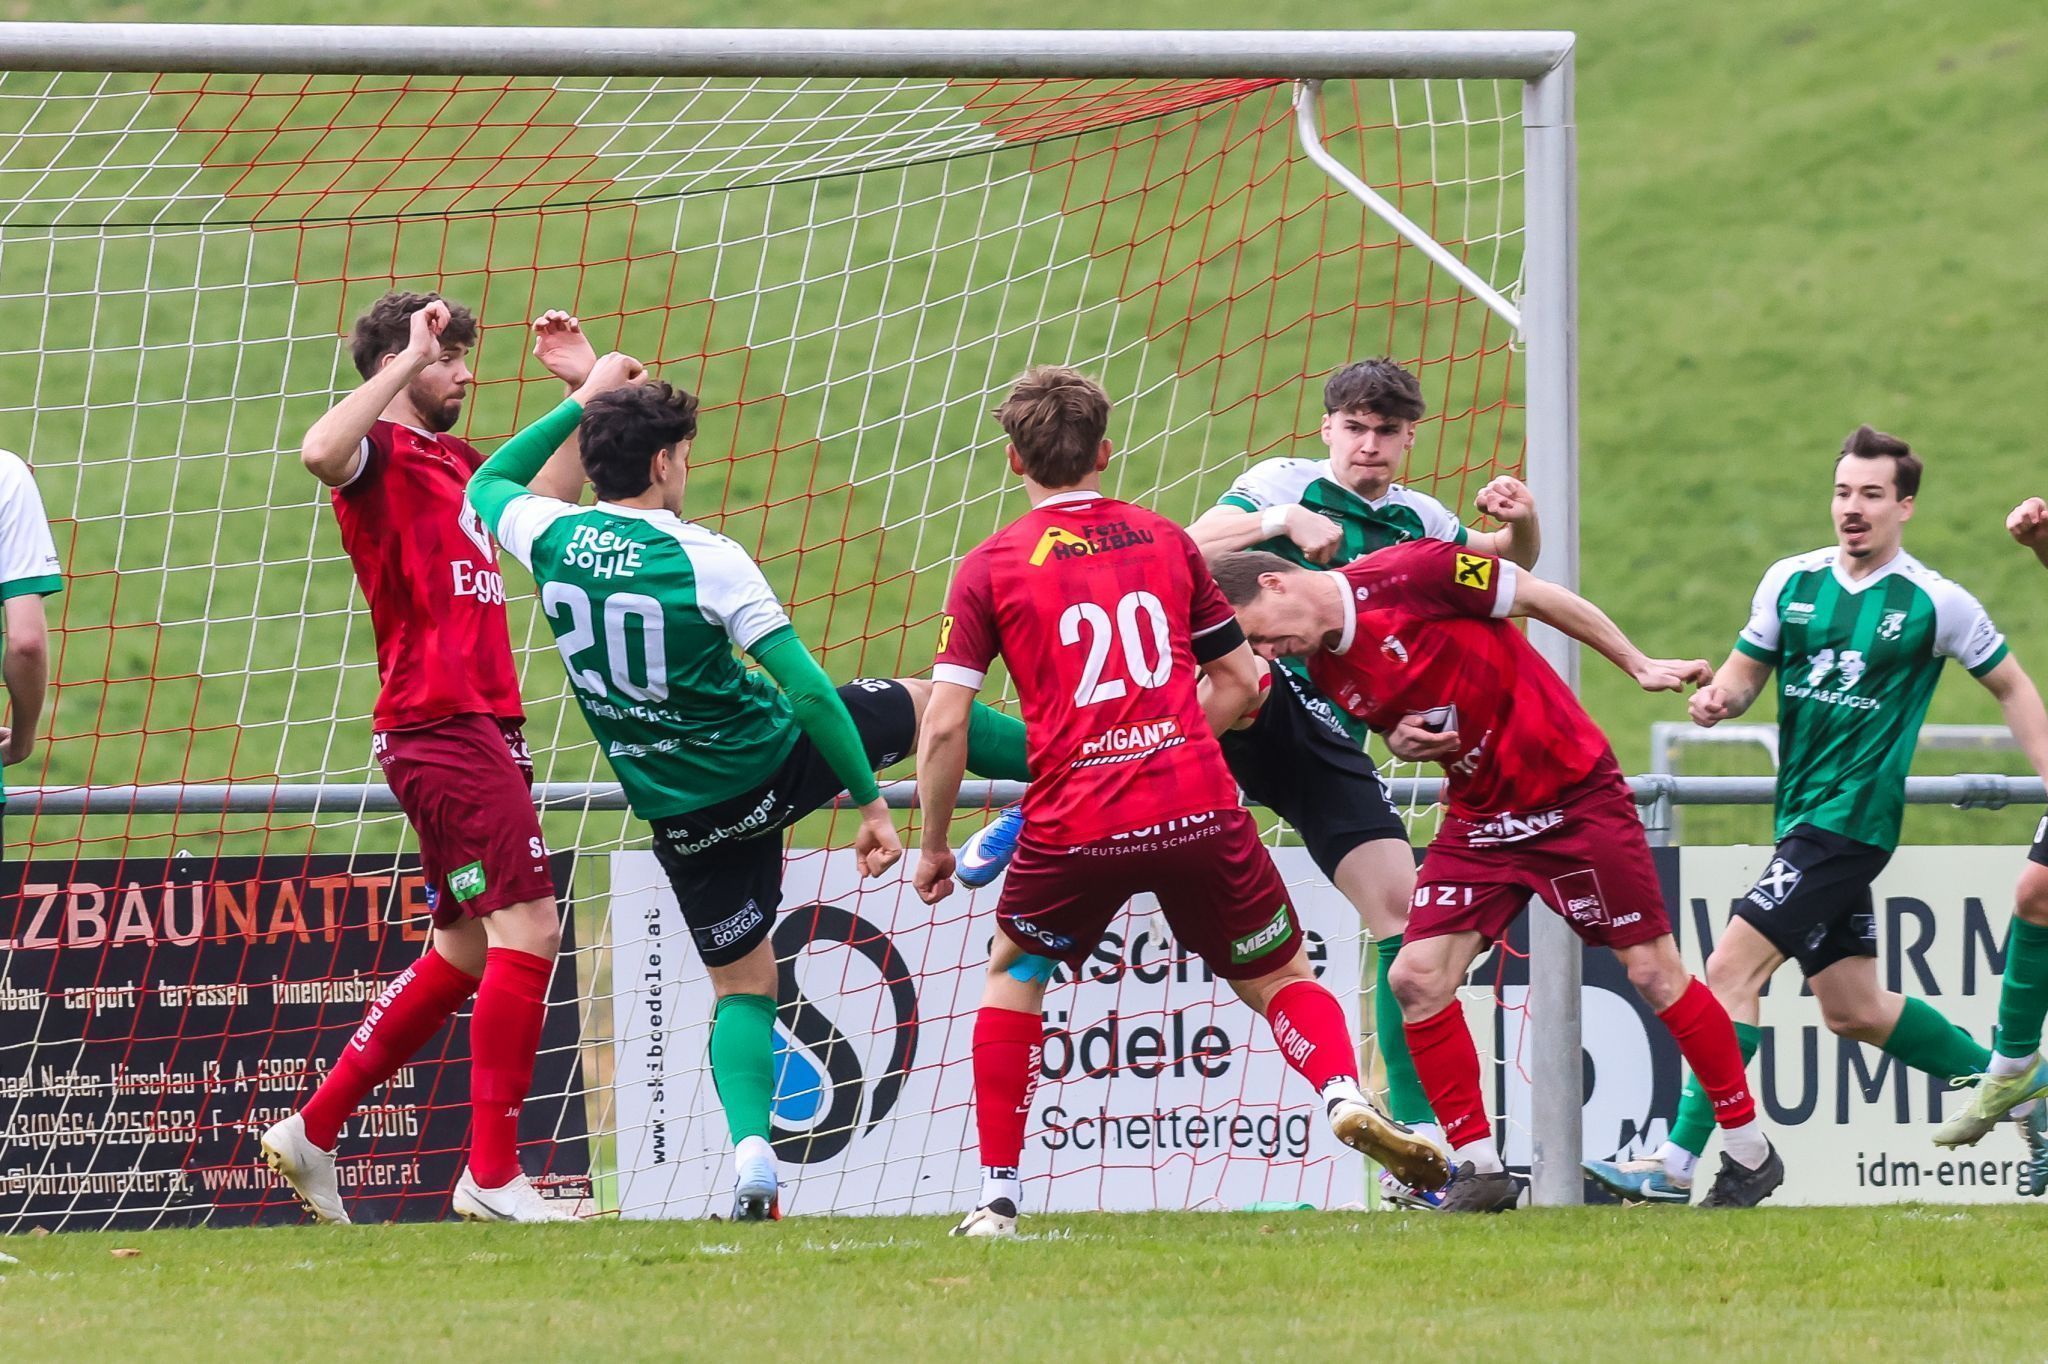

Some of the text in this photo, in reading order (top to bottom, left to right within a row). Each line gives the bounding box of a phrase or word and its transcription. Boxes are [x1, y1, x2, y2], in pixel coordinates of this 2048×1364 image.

[1053, 529, 1155, 561] HOLZBAU
[541, 580, 670, 704] 20
[1058, 590, 1174, 709] 20
[666, 829, 689, 840] Joe
[674, 789, 778, 856] Moosbrugger
[1162, 823, 1222, 849] SCHAFFEN
[714, 913, 760, 947] GORGA
[1236, 917, 1289, 956] MERZ
[64, 979, 136, 1018] carport
[158, 978, 249, 1008] terrassen
[644, 907, 667, 1166] www.skiboedele.at
[1041, 1009, 1233, 1080] ödele
[41, 1064, 104, 1098] Natter,
[111, 1061, 195, 1097] Hirschau
[203, 1059, 227, 1095] 13,
[234, 1058, 309, 1093] A-6882
[212, 1109, 222, 1142] F
[358, 1103, 419, 1138] 20016
[1041, 1105, 1310, 1158] Schetteregg
